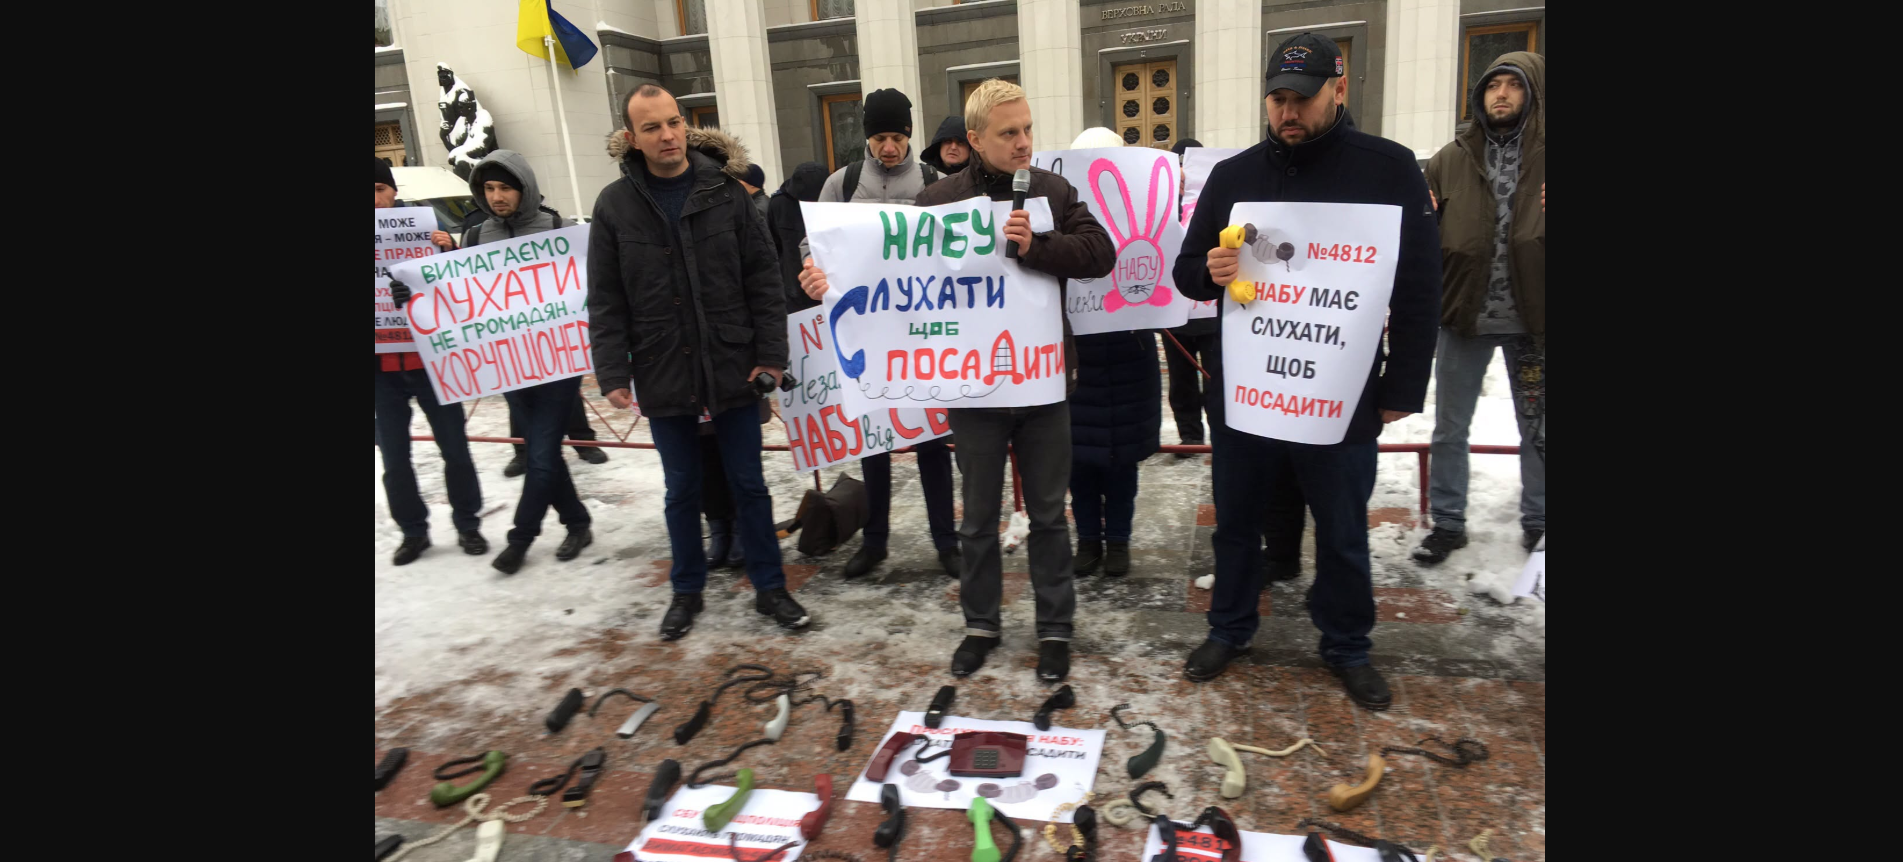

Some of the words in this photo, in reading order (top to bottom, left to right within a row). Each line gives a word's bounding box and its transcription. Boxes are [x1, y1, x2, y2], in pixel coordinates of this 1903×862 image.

[1101, 5, 1154, 20] ВЕРХОВНА
[1158, 1, 1186, 13] РАДА
[1120, 28, 1167, 44] УКРАЇНИ
[377, 217, 416, 229] МОЖЕ
[394, 231, 432, 243] МОЖЕ
[879, 209, 997, 261] НАБУ
[383, 246, 434, 261] ПРАВО
[420, 236, 570, 285] ВИМАГАЄМО
[1307, 242, 1377, 265] №4812
[1117, 255, 1159, 283] НАБУ
[406, 255, 582, 336] СЛУХАТИ
[1254, 280, 1306, 305] НАБУ
[1309, 287, 1360, 311] МАЄ
[428, 330, 458, 354] НЕ
[1251, 316, 1347, 351] СЛУХАТИ,
[886, 329, 1066, 386] ПОСАДИТИ
[1266, 354, 1316, 380] ЩОБ
[1235, 384, 1344, 419] ПОСАДИТИ
[785, 404, 863, 472] НАБУ
[862, 414, 895, 451] від
